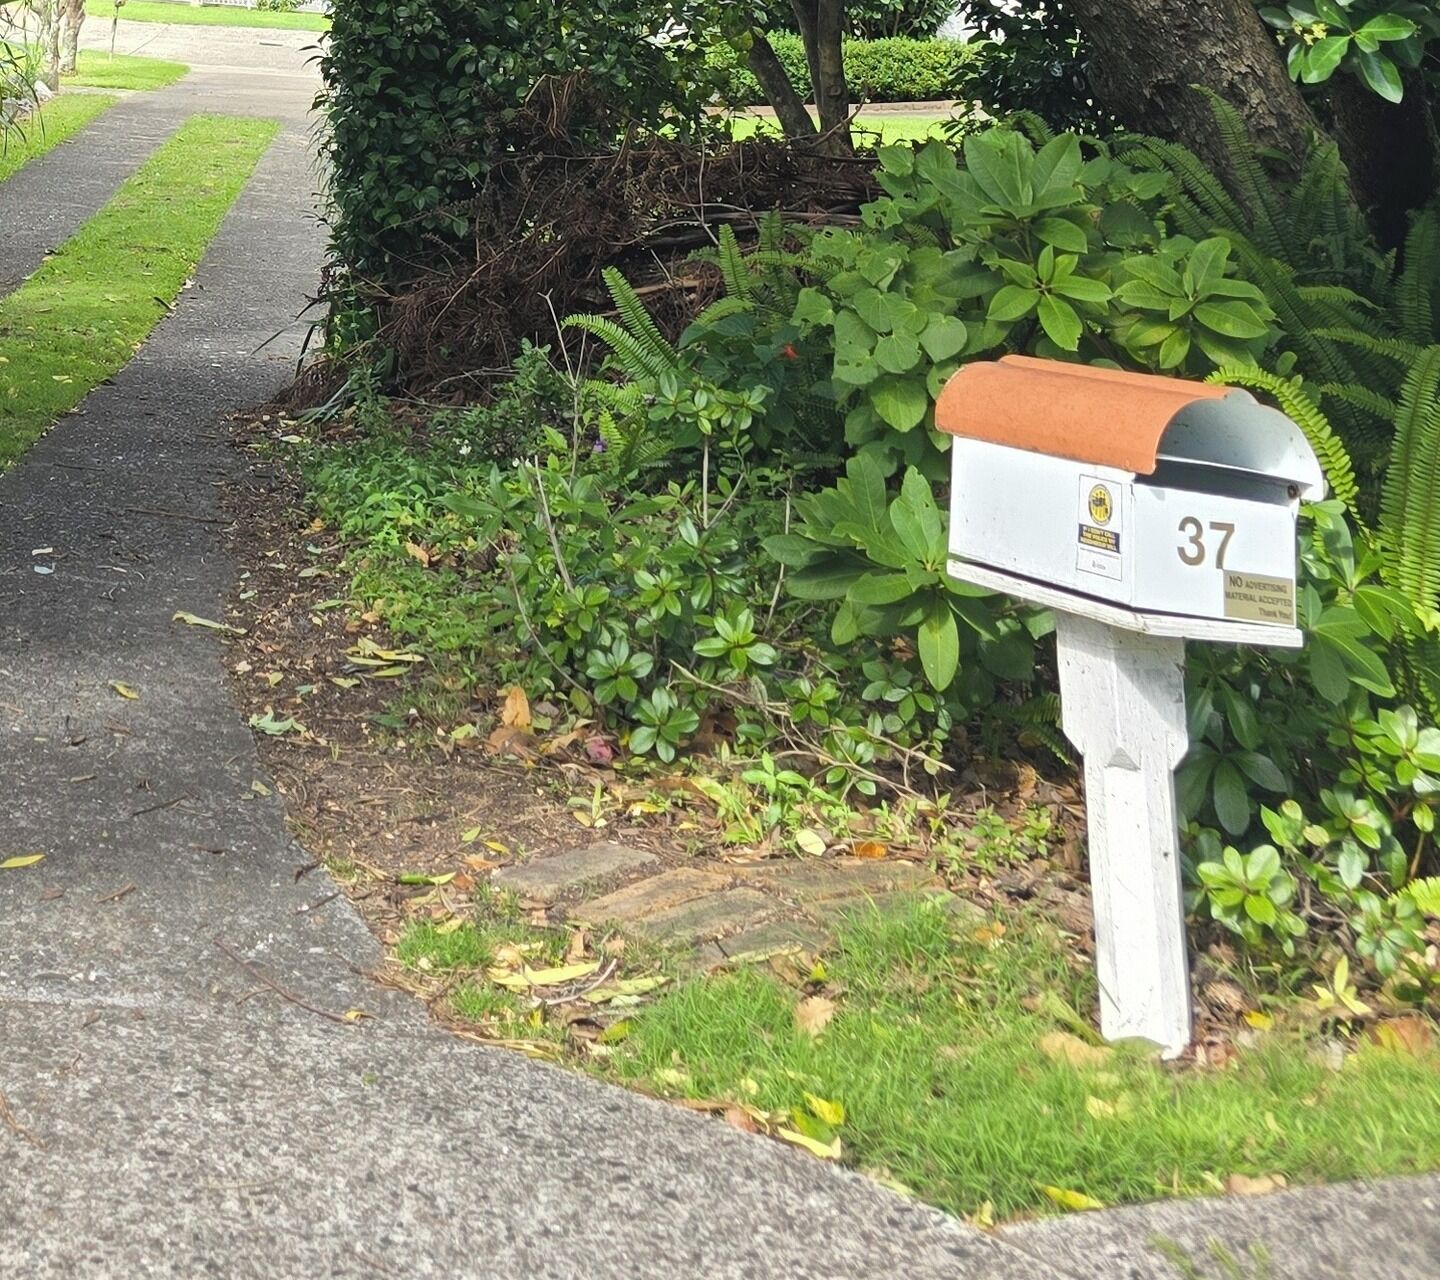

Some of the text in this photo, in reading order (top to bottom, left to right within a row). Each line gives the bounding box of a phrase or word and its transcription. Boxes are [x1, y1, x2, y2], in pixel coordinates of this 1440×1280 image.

[1177, 516, 1235, 569] 37
[1229, 575, 1287, 594] NO ADVERTISING
[1224, 591, 1292, 607] MATERIAL ACCEPTED
